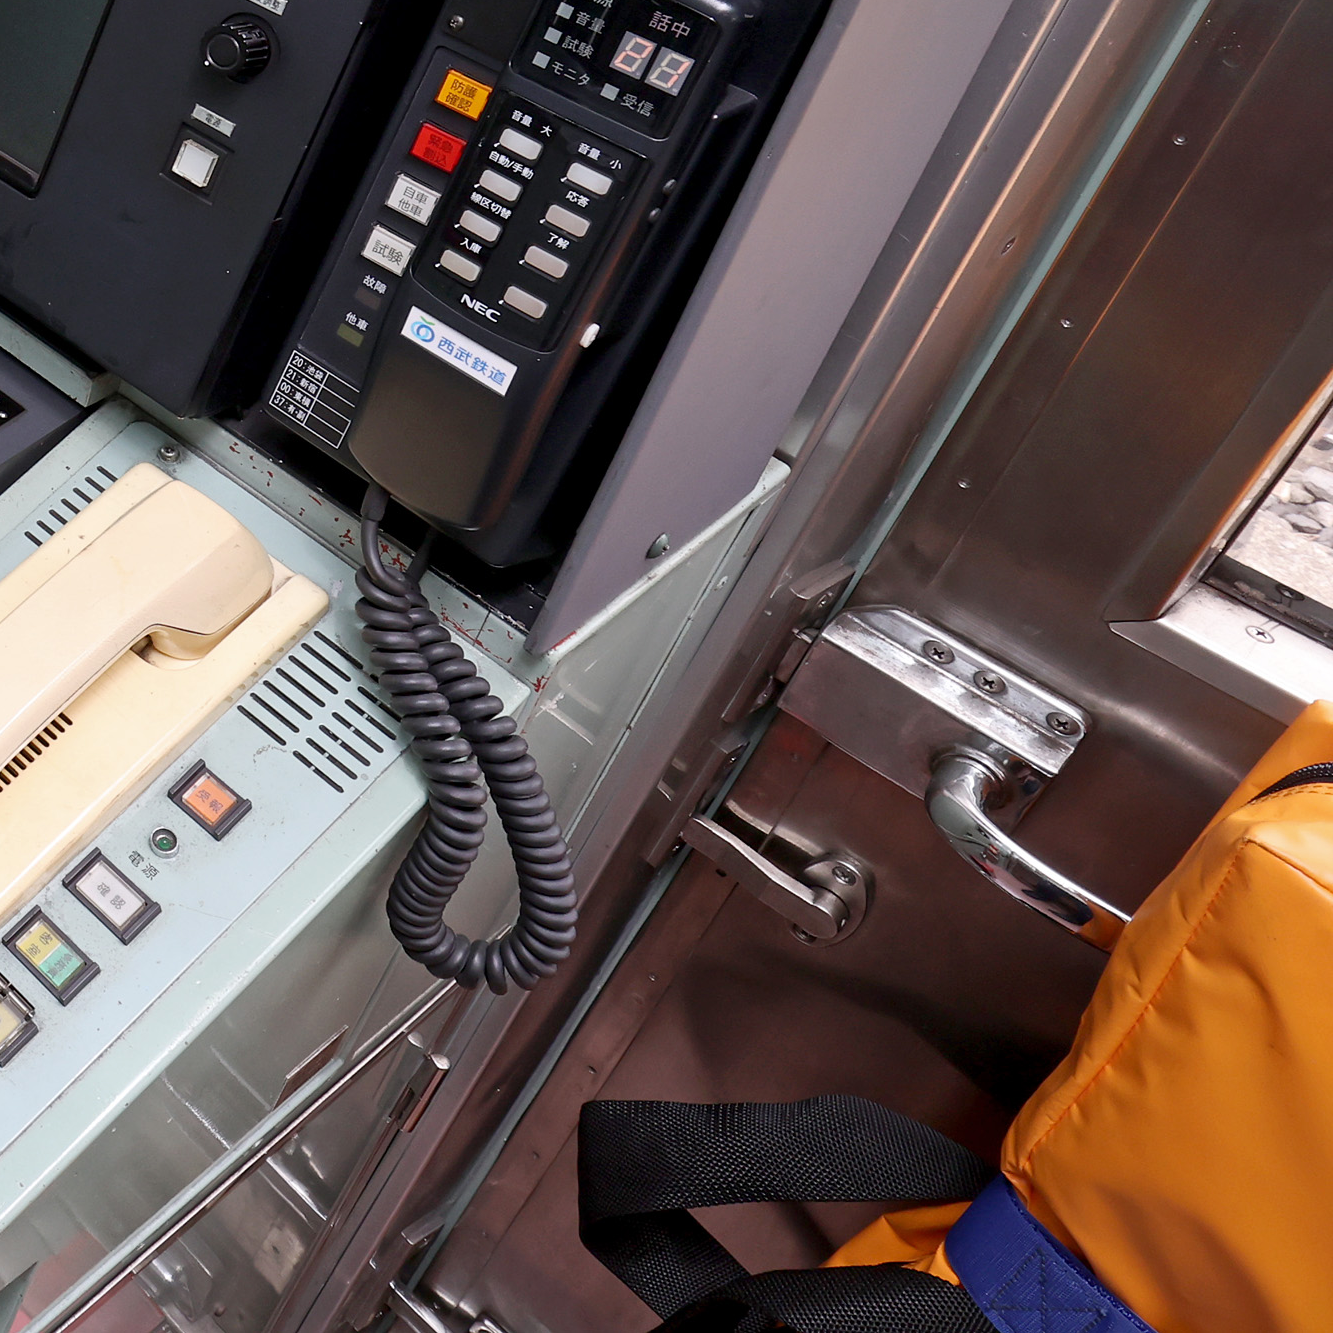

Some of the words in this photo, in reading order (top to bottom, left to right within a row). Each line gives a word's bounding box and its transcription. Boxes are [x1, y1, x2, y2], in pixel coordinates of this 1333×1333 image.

[575, 10, 607, 36] 音量
[648, 10, 692, 40] 話中
[561, 34, 595, 60] 試験
[552, 60, 591, 87] モニタ
[451, 78, 478, 100] 防護
[445, 92, 473, 113] 確認
[620, 93, 655, 118] 受信
[511, 109, 533, 127] 音量
[540, 124, 553, 138] 大
[428, 134, 454, 153] 緊急
[577, 141, 602, 161] 音量
[609, 157, 623, 171] 小
[487, 150, 535, 180] 自動/手動
[396, 198, 423, 218] 他車
[402, 186, 429, 205] 自車
[470, 191, 513, 220] 線区切替
[565, 189, 591, 208] 応答
[372, 239, 404, 266] 試験
[459, 237, 483, 255] 入庫
[547, 232, 571, 251] 了解
[362, 274, 388, 295] 故障
[460, 293, 502, 323] NEC
[345, 311, 370, 332] 他車
[437, 336, 508, 388] 西武鉄道
[128, 850, 161, 881] 電源
[96, 881, 126, 911] 確認
[25, 931, 54, 959] 客室
